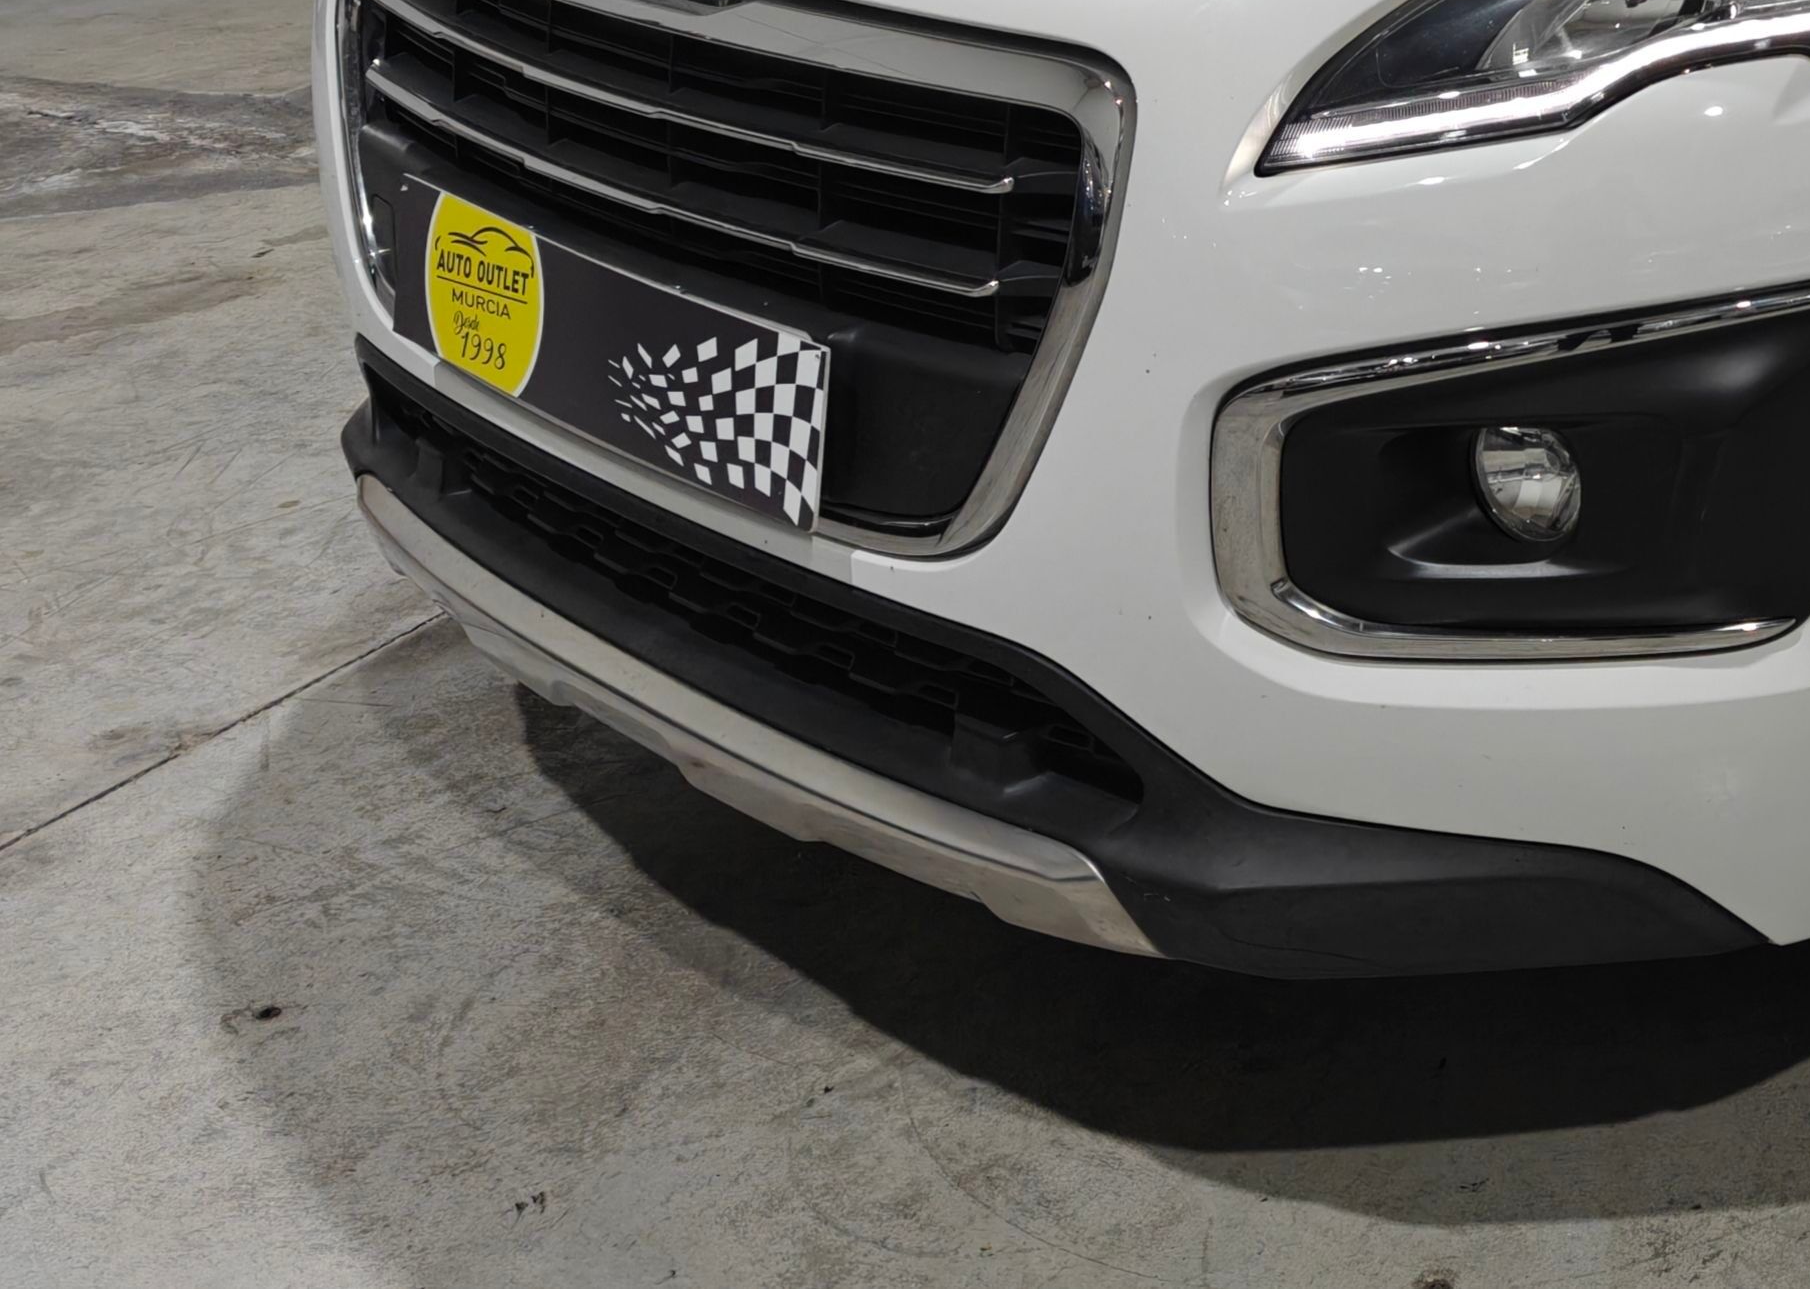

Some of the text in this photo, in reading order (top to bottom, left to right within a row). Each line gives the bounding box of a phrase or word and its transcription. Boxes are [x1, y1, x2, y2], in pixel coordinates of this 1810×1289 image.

[436, 249, 530, 296] AUTO OUTLET
[451, 288, 511, 320] MURCIA
[453, 310, 480, 335] Desde
[461, 331, 507, 370] 1998
